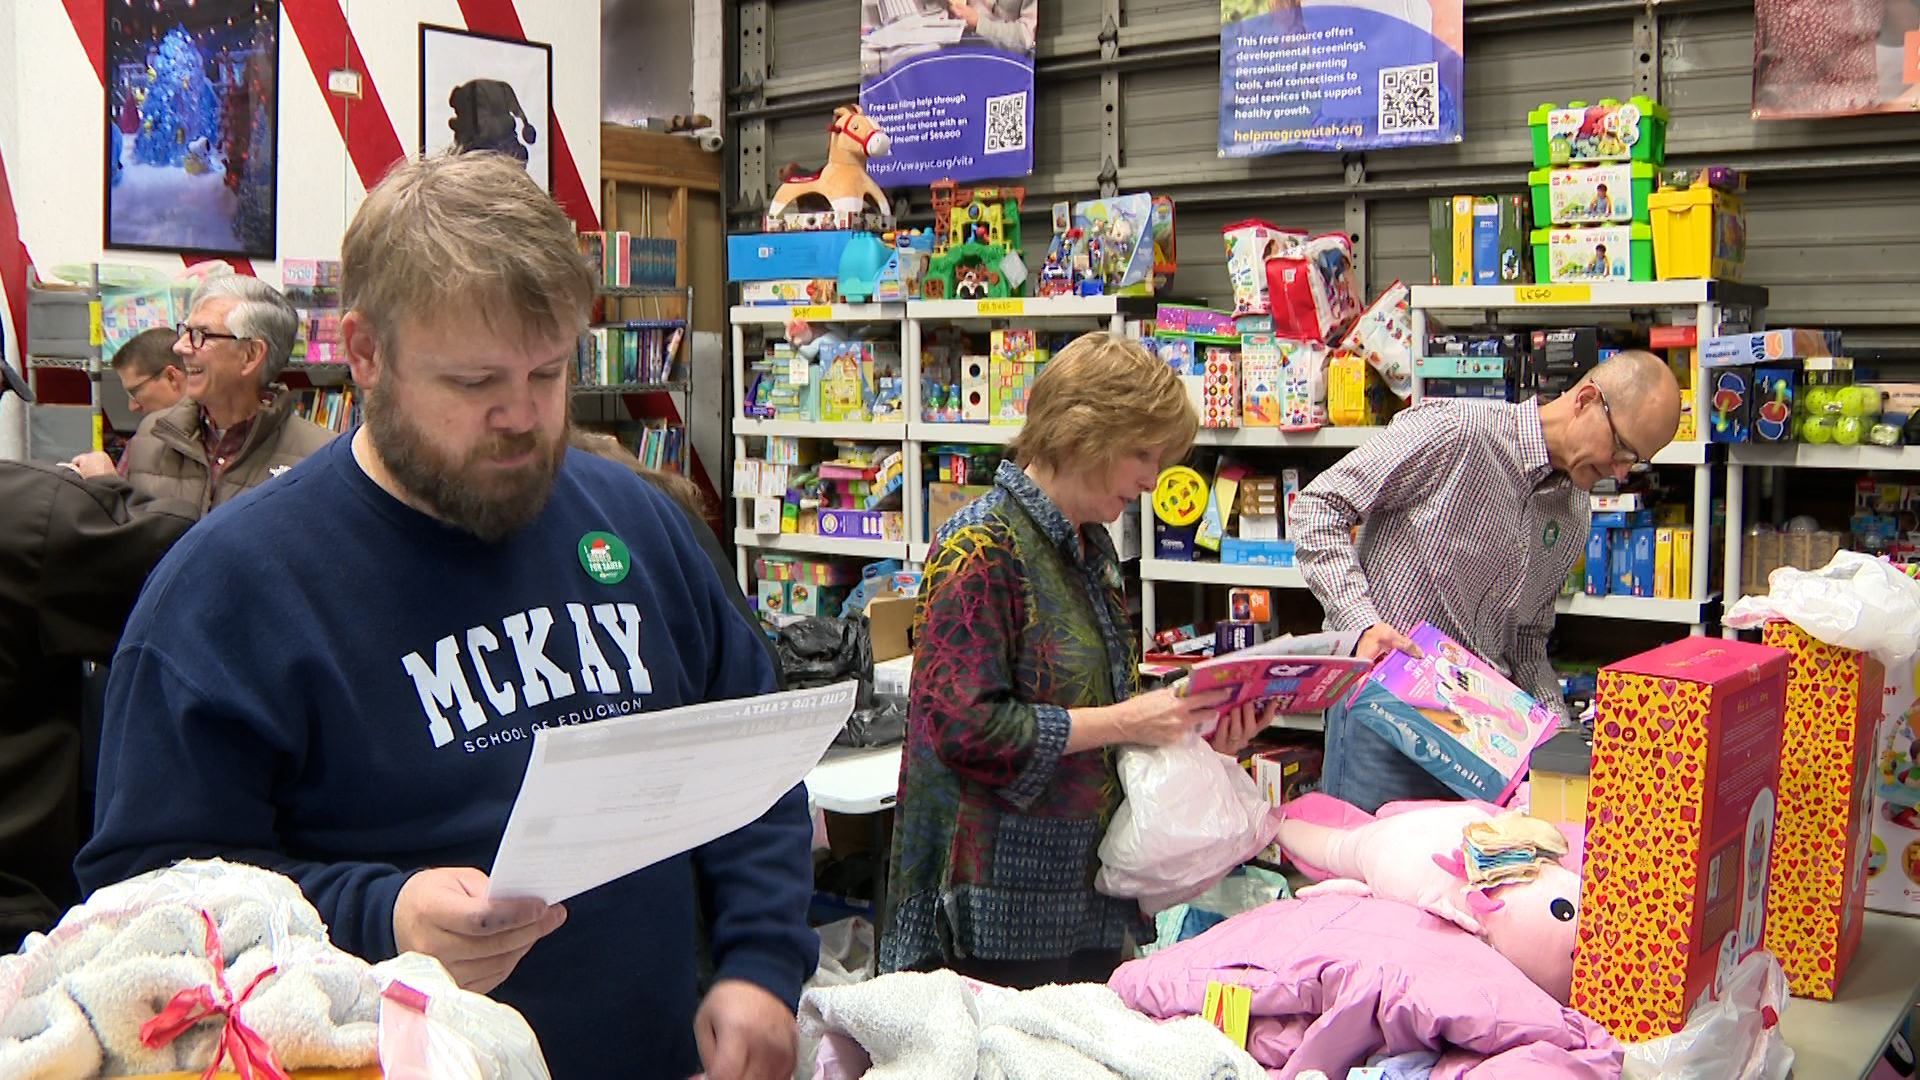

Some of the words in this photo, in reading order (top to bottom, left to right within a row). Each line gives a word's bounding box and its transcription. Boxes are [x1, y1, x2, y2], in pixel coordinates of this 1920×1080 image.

[1236, 36, 1258, 47] This
[1259, 34, 1279, 45] free
[1281, 31, 1323, 43] resource
[1324, 26, 1354, 38] offers
[1236, 46, 1310, 62] developmental
[1311, 41, 1367, 55] screenings,
[1236, 61, 1298, 77] personalized
[1300, 58, 1348, 73] parenting
[1235, 79, 1263, 91] tools,
[1265, 77, 1283, 88] and
[1285, 73, 1345, 87] connections
[1346, 71, 1358, 81] to
[868, 102, 886, 112] Free
[887, 102, 898, 111] tax
[899, 99, 916, 111] filing
[916, 96, 933, 108] help
[934, 93, 966, 106] through
[1235, 94, 1260, 105] local
[1261, 91, 1300, 104] services
[1301, 89, 1322, 100] that
[1323, 85, 1363, 99] support
[932, 107, 946, 116] Tax
[1235, 107, 1273, 121] healthy
[1274, 105, 1312, 118] growth.
[906, 122, 917, 133] for
[918, 120, 938, 131] those
[939, 117, 957, 128] with
[957, 117, 968, 126] an
[1234, 124, 1364, 144] helpmegrowutah.org
[920, 131, 929, 141] of
[401, 602, 653, 749] MCKAY
[463, 726, 528, 754] SCHOOL
[531, 720, 552, 733] OF
[557, 698, 643, 726] EDUCATION
